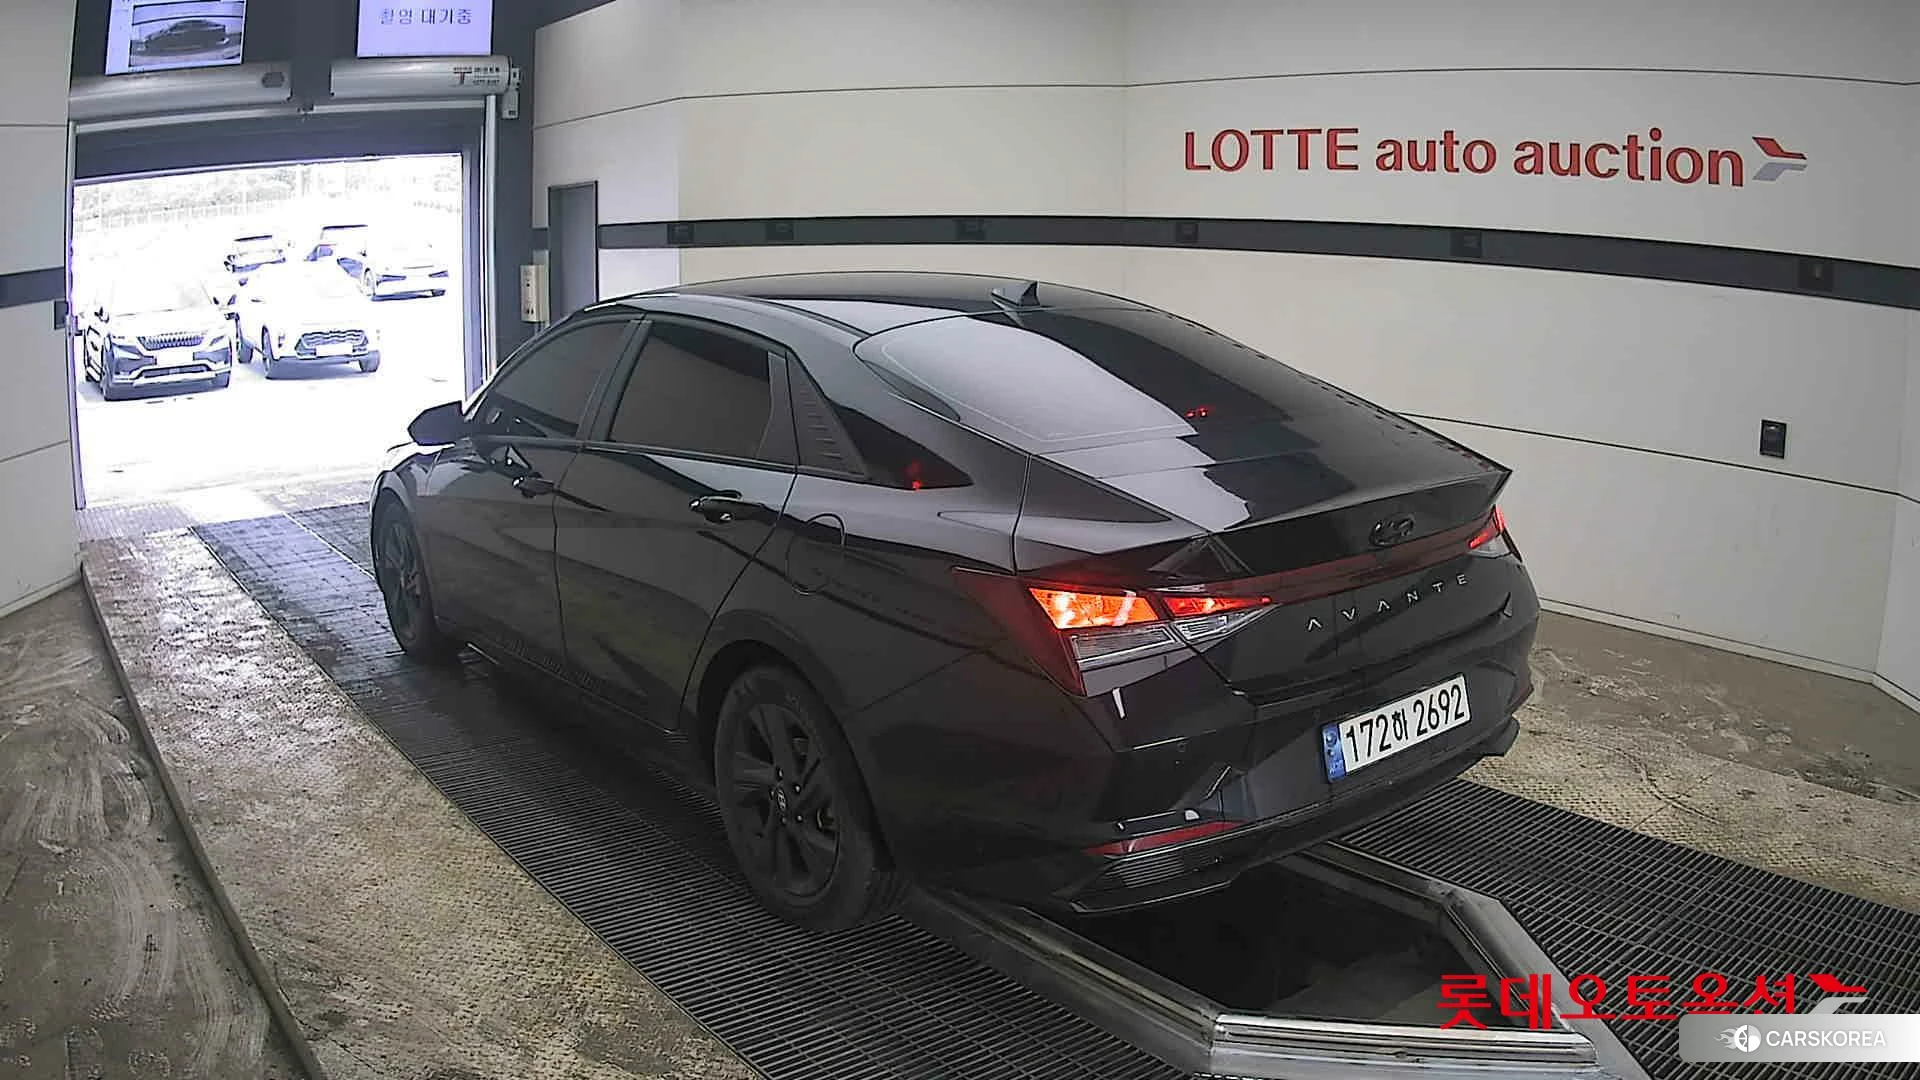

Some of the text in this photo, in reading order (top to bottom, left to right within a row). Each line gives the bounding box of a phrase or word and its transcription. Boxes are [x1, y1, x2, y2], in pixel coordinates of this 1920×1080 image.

[421, 7, 473, 25] 대기중
[1185, 128, 1744, 187] LOTTE auto auction
[1306, 573, 1469, 632] AVANTE
[1346, 684, 1465, 763] 172하 2692
